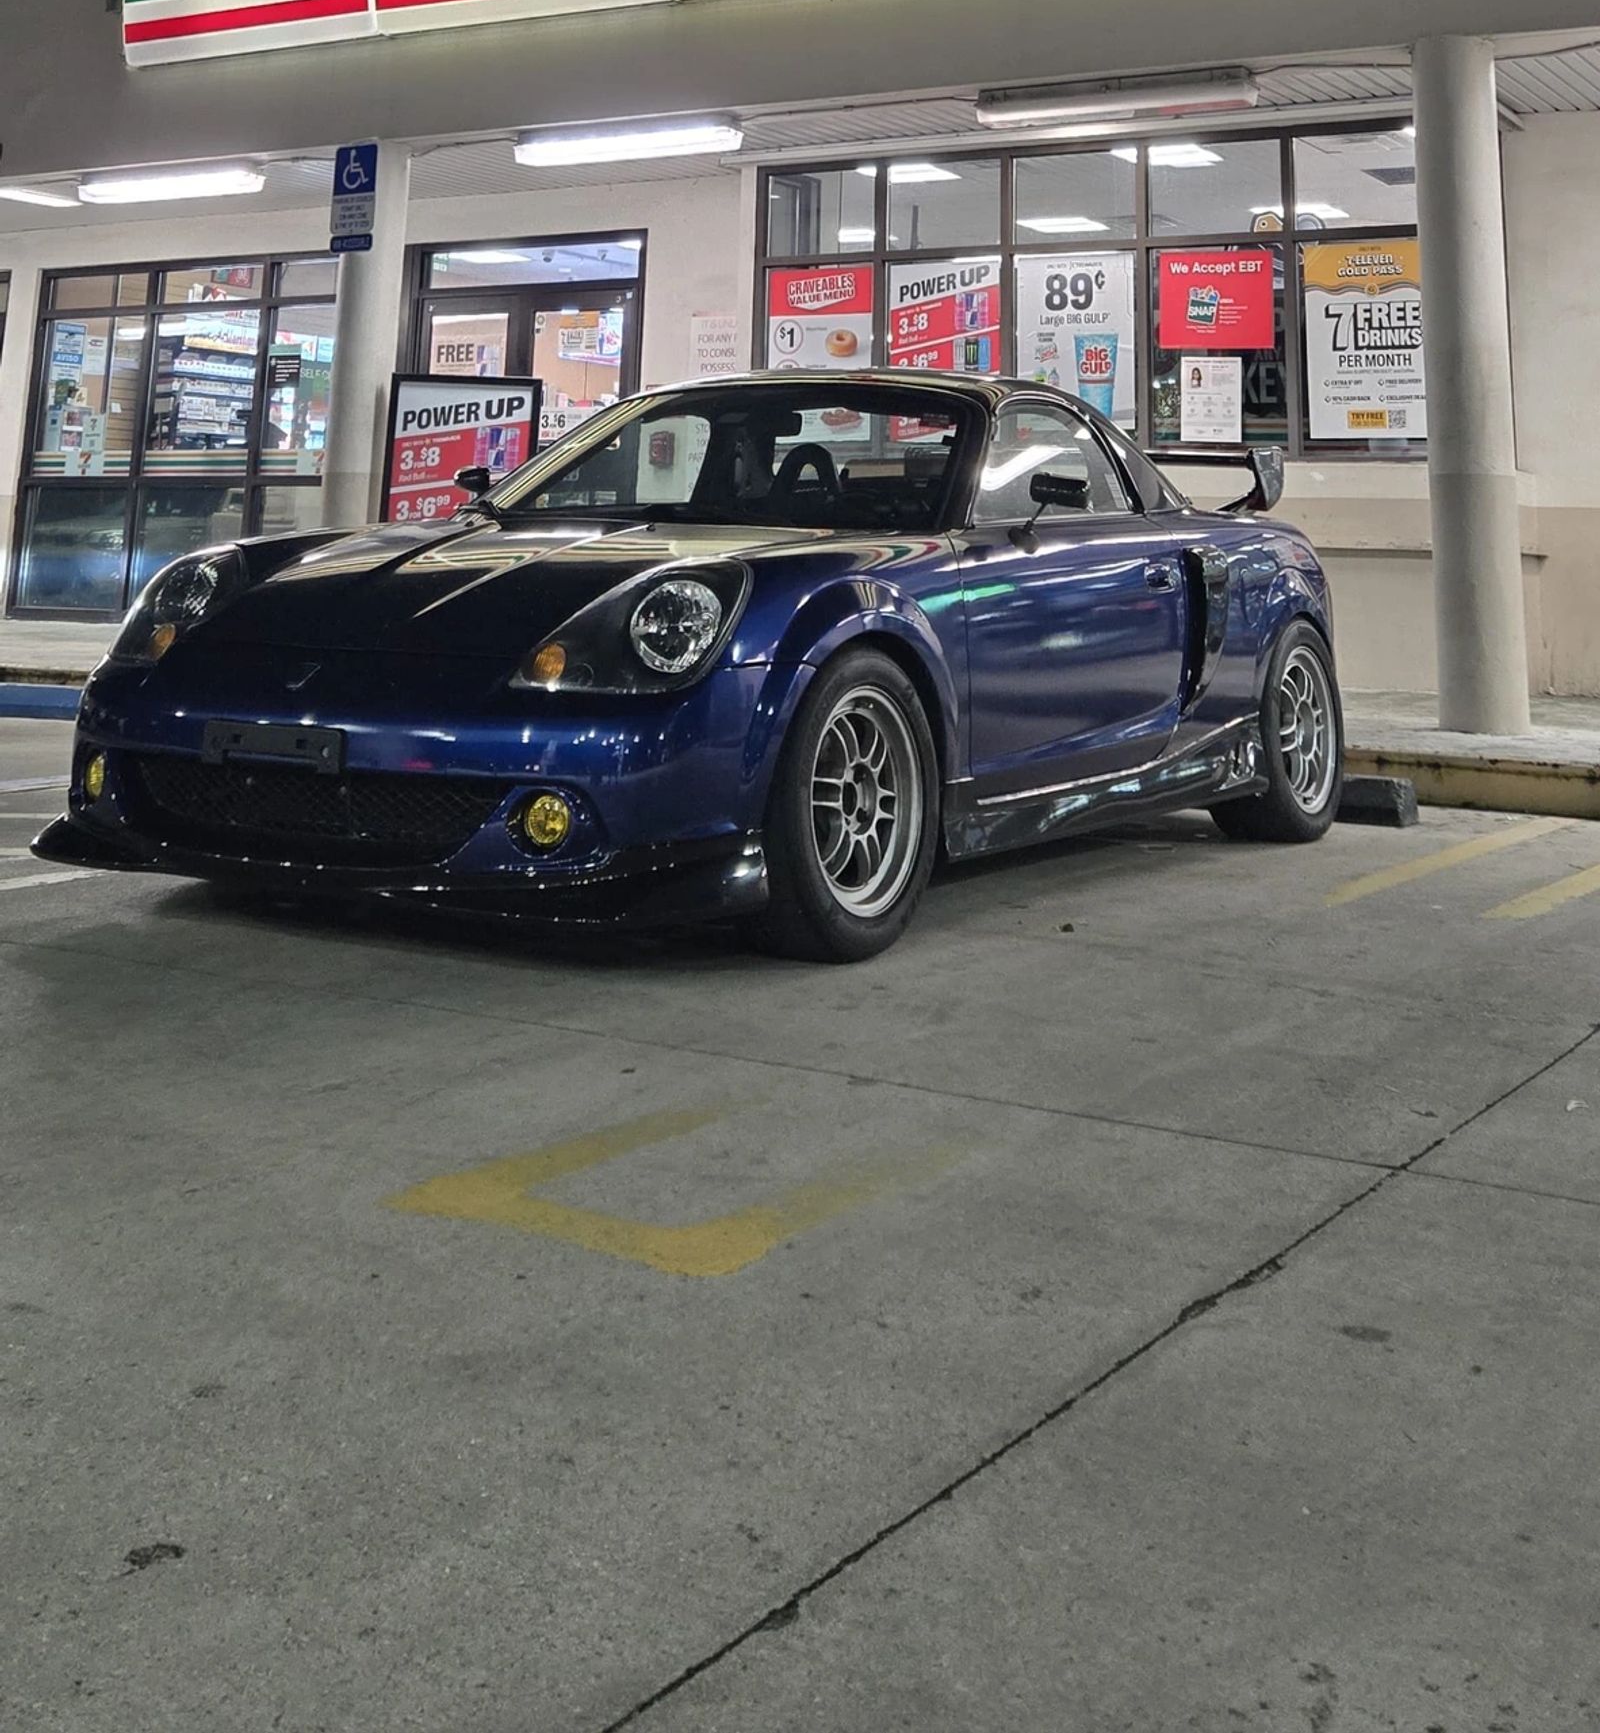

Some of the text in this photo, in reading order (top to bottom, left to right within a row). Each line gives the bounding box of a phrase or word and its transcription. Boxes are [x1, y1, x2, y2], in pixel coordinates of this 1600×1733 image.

[1170, 260, 1263, 276] We Accept EBT
[1337, 266, 1403, 277] GOLD PASS
[788, 274, 854, 296] CRAVEABLES
[900, 265, 990, 302] POWER UP
[789, 289, 854, 305] VALUE MENU
[1188, 305, 1216, 317] SNAP
[899, 317, 908, 335] 3
[913, 313, 928, 330] $8
[1040, 315, 1064, 328] Large
[1067, 314, 1082, 324] BIG
[1325, 300, 1421, 351] 7 FREE
[698, 334, 714, 343] FOR
[715, 333, 732, 343] ANY
[780, 327, 795, 348] $1
[1355, 328, 1424, 351] DRINKS
[436, 343, 475, 364] FREE
[697, 348, 708, 358] TO
[1085, 347, 1109, 361] BIG
[1339, 353, 1412, 367] PER MONTH
[1080, 361, 1112, 374] GULP
[402, 396, 525, 431] POWER UP
[541, 414, 550, 429] 3
[400, 450, 414, 470] 3
[420, 446, 440, 467] $8
[396, 500, 410, 521] 3
